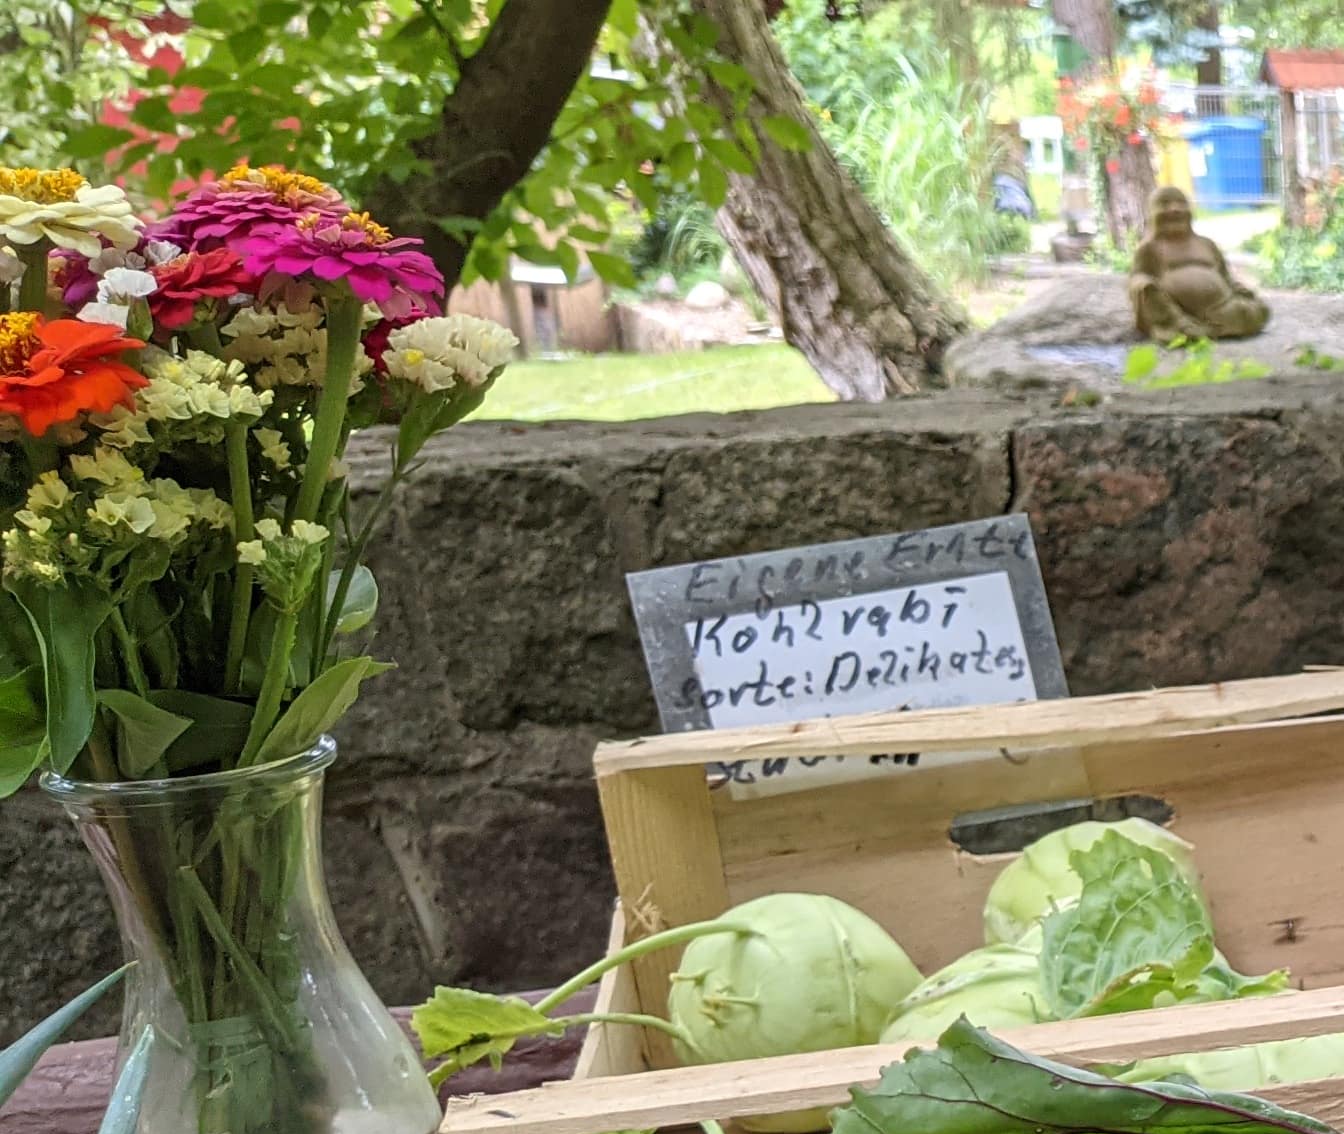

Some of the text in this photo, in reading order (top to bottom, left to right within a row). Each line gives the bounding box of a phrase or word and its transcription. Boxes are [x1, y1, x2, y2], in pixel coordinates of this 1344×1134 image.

[684, 523, 1032, 618] Eigene Ernte
[690, 586, 966, 657] Kohlrabi
